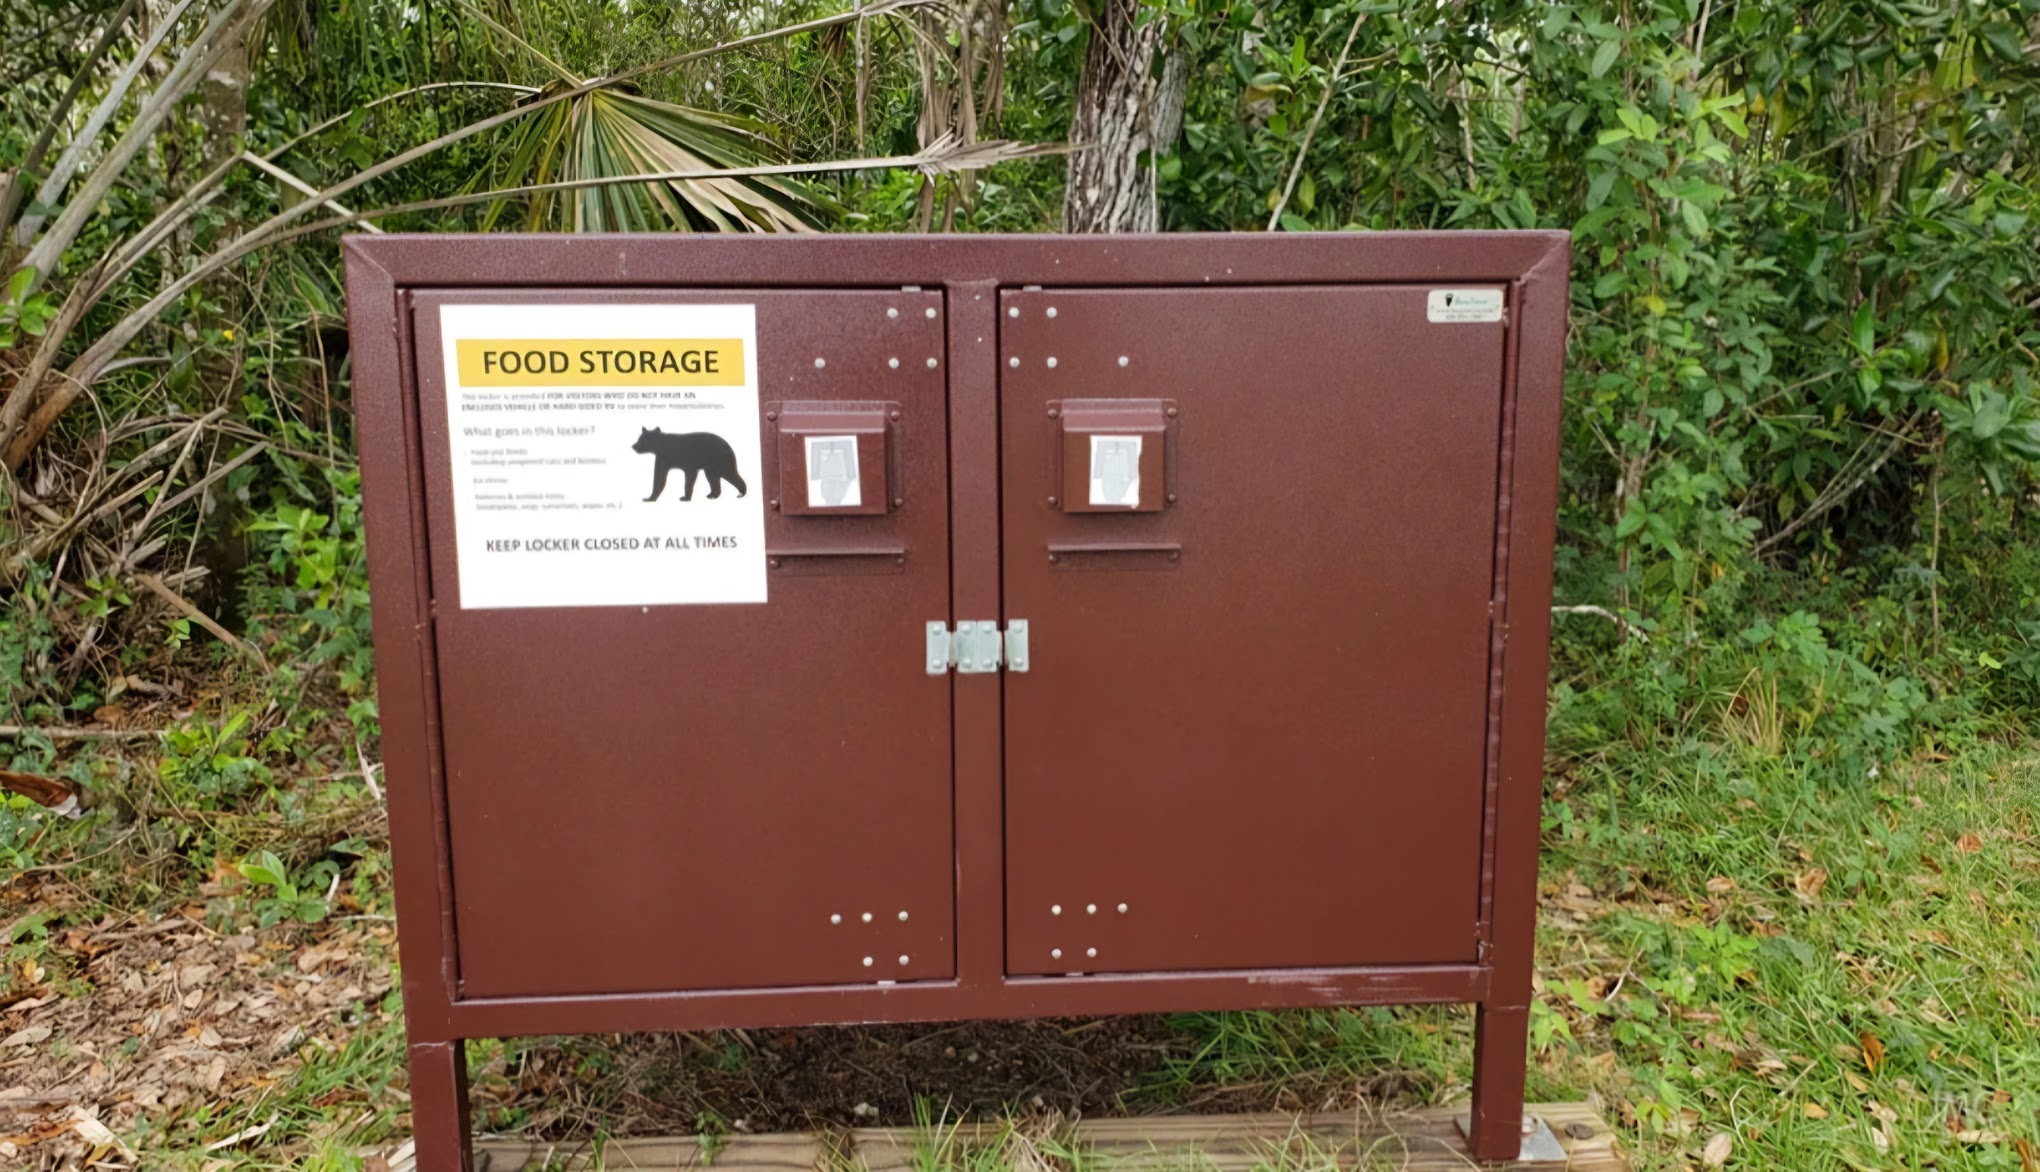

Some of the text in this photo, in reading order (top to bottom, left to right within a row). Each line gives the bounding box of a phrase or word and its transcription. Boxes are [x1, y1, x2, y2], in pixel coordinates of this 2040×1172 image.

[483, 350, 719, 374] FOOD STORAGE
[463, 425, 596, 439] What goes in this locker?
[486, 536, 738, 552] KEEP LOCKER CLOSED AT ALL TIMES
